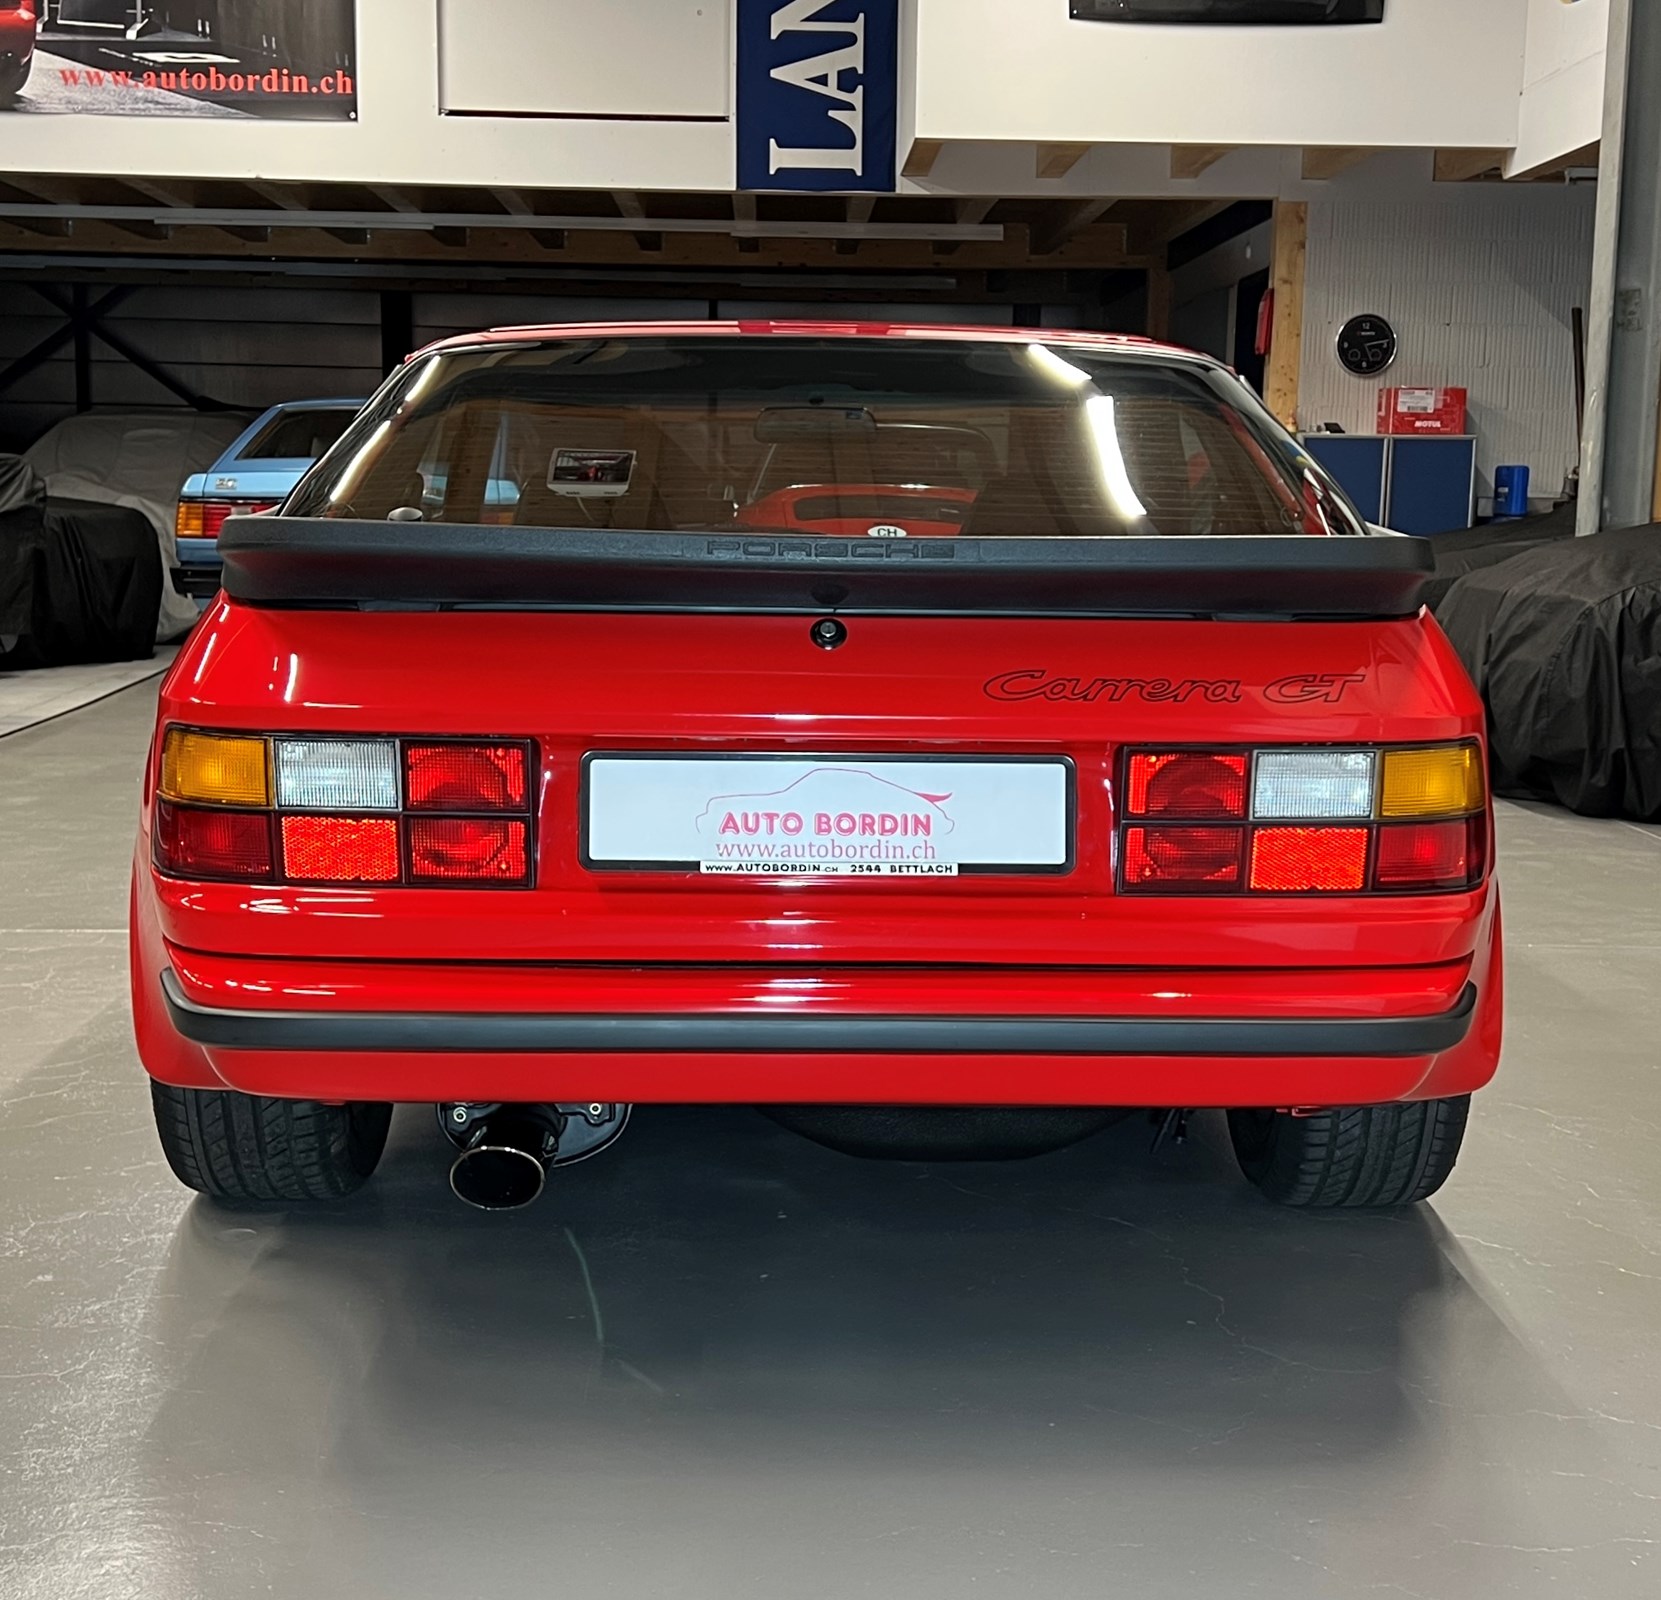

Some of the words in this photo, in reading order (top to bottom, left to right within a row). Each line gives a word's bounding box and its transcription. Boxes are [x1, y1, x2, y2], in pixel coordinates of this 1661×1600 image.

[59, 67, 353, 94] www.autobordin.ch
[1414, 420, 1441, 428] MOTUL
[877, 527, 898, 537] CH
[707, 541, 955, 558] PORSCHE
[983, 670, 1242, 702] Carrera
[1263, 673, 1366, 704] GT
[719, 812, 804, 836] AUTO
[814, 813, 932, 836] BORDIN
[716, 839, 936, 860] www.autobordin.ch
[850, 864, 881, 873] 2544
[890, 865, 953, 874] BETTLACH
